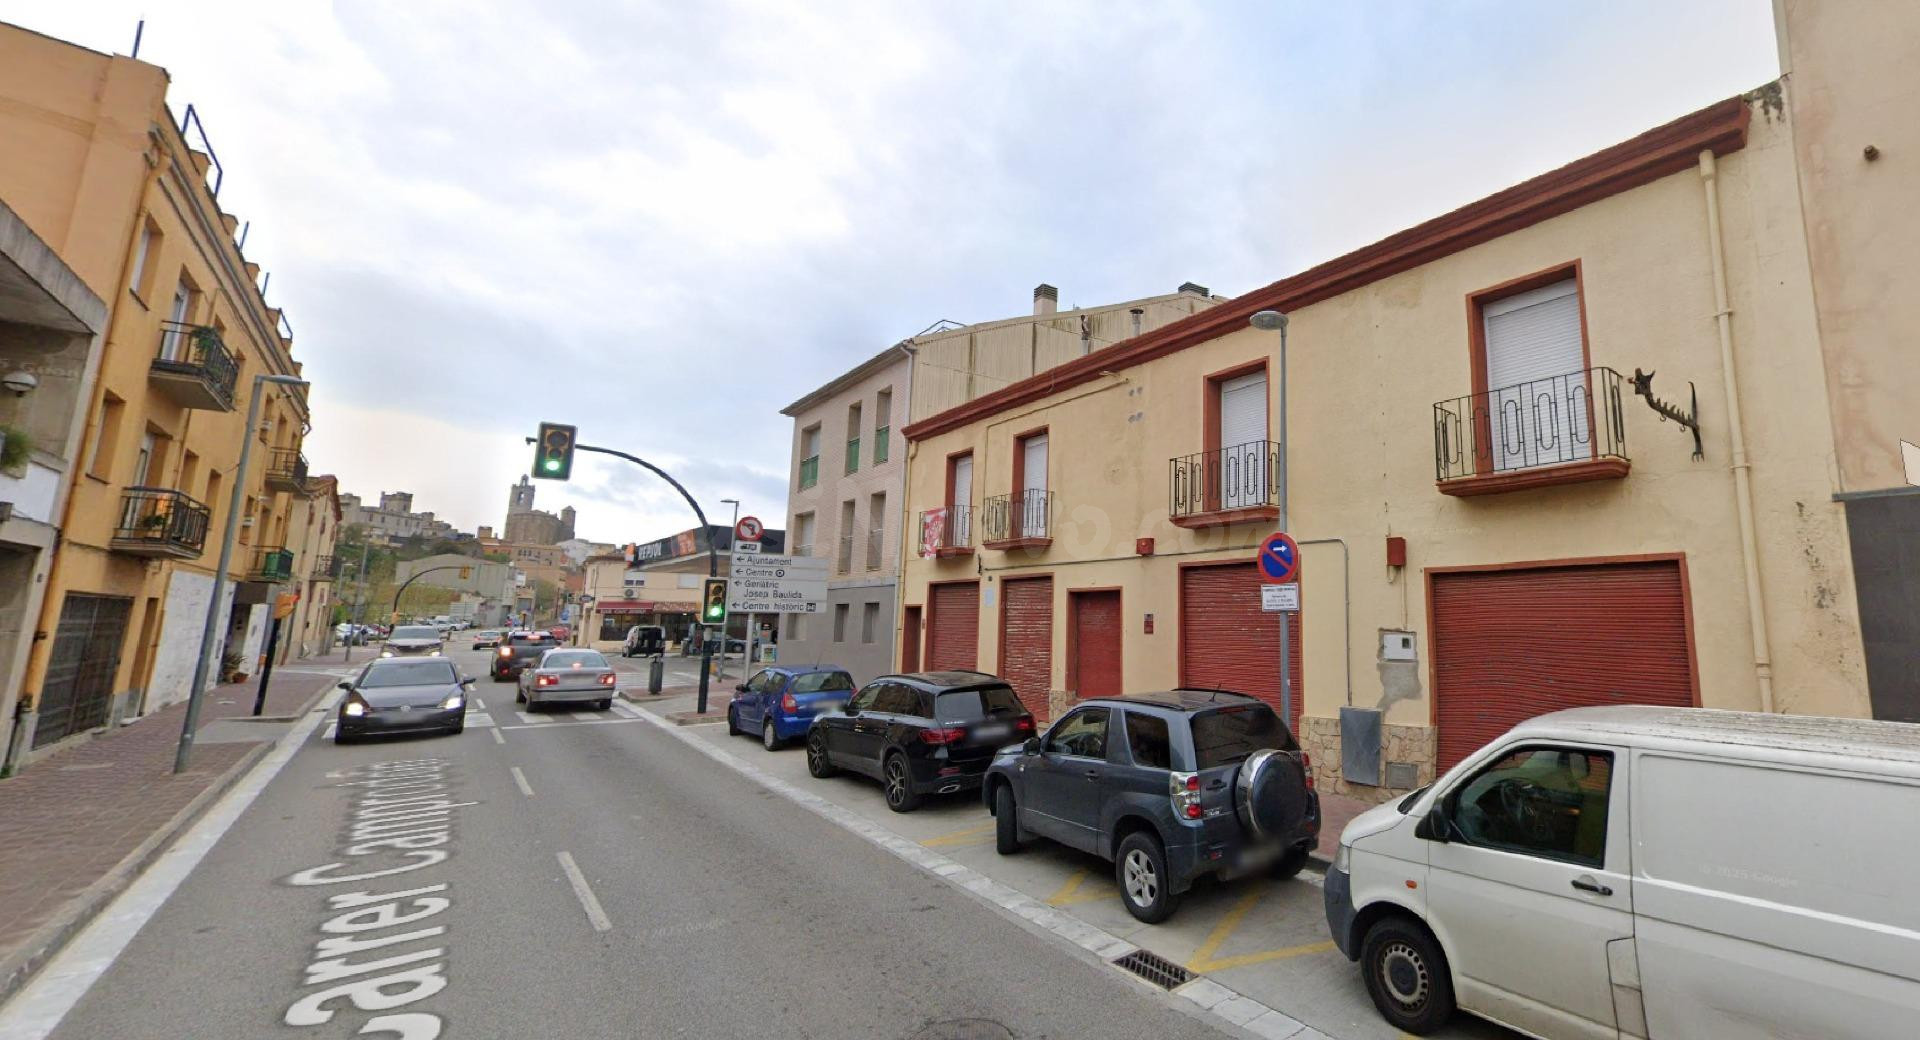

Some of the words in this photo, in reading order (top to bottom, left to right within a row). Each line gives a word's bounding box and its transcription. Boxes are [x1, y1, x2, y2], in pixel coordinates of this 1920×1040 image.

[747, 555, 792, 566] Ajuntament
[745, 568, 773, 577] Centre
[743, 588, 769, 599] Josep
[742, 601, 770, 610] Centre
